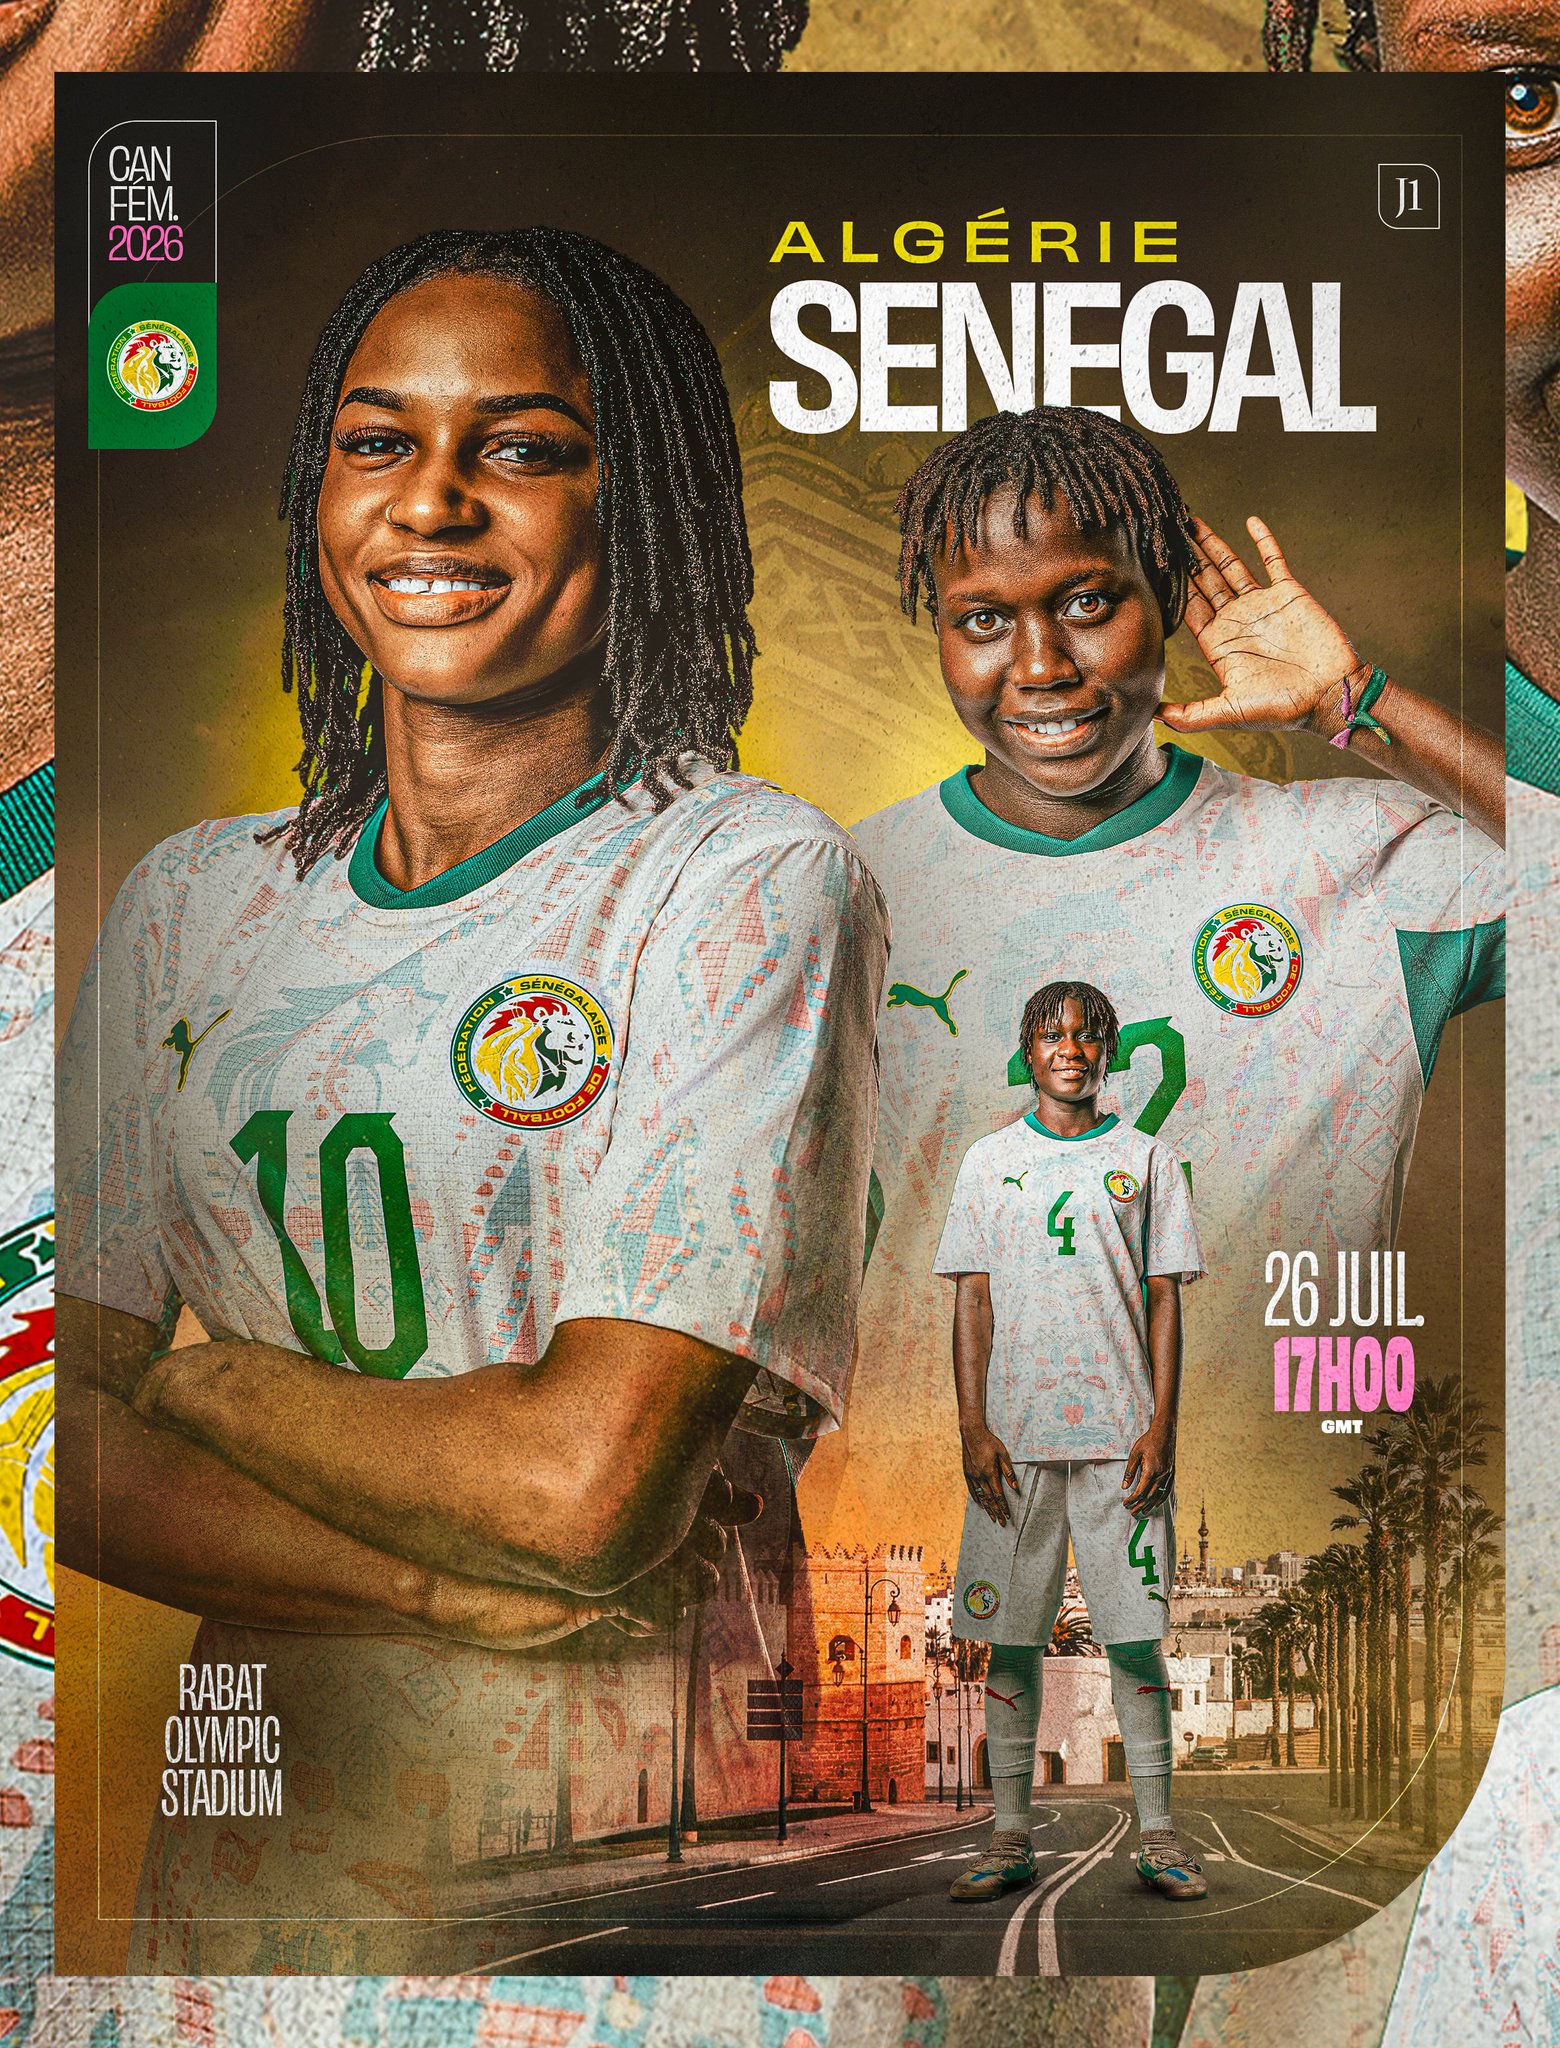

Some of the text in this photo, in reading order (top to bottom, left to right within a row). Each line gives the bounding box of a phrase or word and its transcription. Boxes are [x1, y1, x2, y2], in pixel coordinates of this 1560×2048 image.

[109, 145, 171, 182] CAN
[110, 175, 179, 221] FÉM.
[1395, 177, 1423, 219] J1
[108, 224, 184, 262] 2026
[768, 207, 1178, 264] ALGÉRIE
[769, 279, 1377, 435] SENEGAL
[141, 388, 187, 408] FOOTBALL
[1196, 906, 1299, 1013] FÉDÉRATION SÉNÉGALAISE DE FOOTBALL
[454, 978, 608, 1123] FÉDÉRATION SÉNÉGALAISE DE FOOTBALL
[228, 1110, 429, 1380] 10
[1047, 1190, 1077, 1256] 4
[1264, 1250, 1425, 1327] 26 JUIL.
[1273, 1335, 1416, 1413] 17H00
[1320, 1419, 1364, 1434] GMT
[1127, 1518, 1160, 1586] 4
[179, 1663, 267, 1711] RABAT
[164, 1715, 280, 1764] OLYMPIC
[161, 1768, 282, 1817] STADIUM
